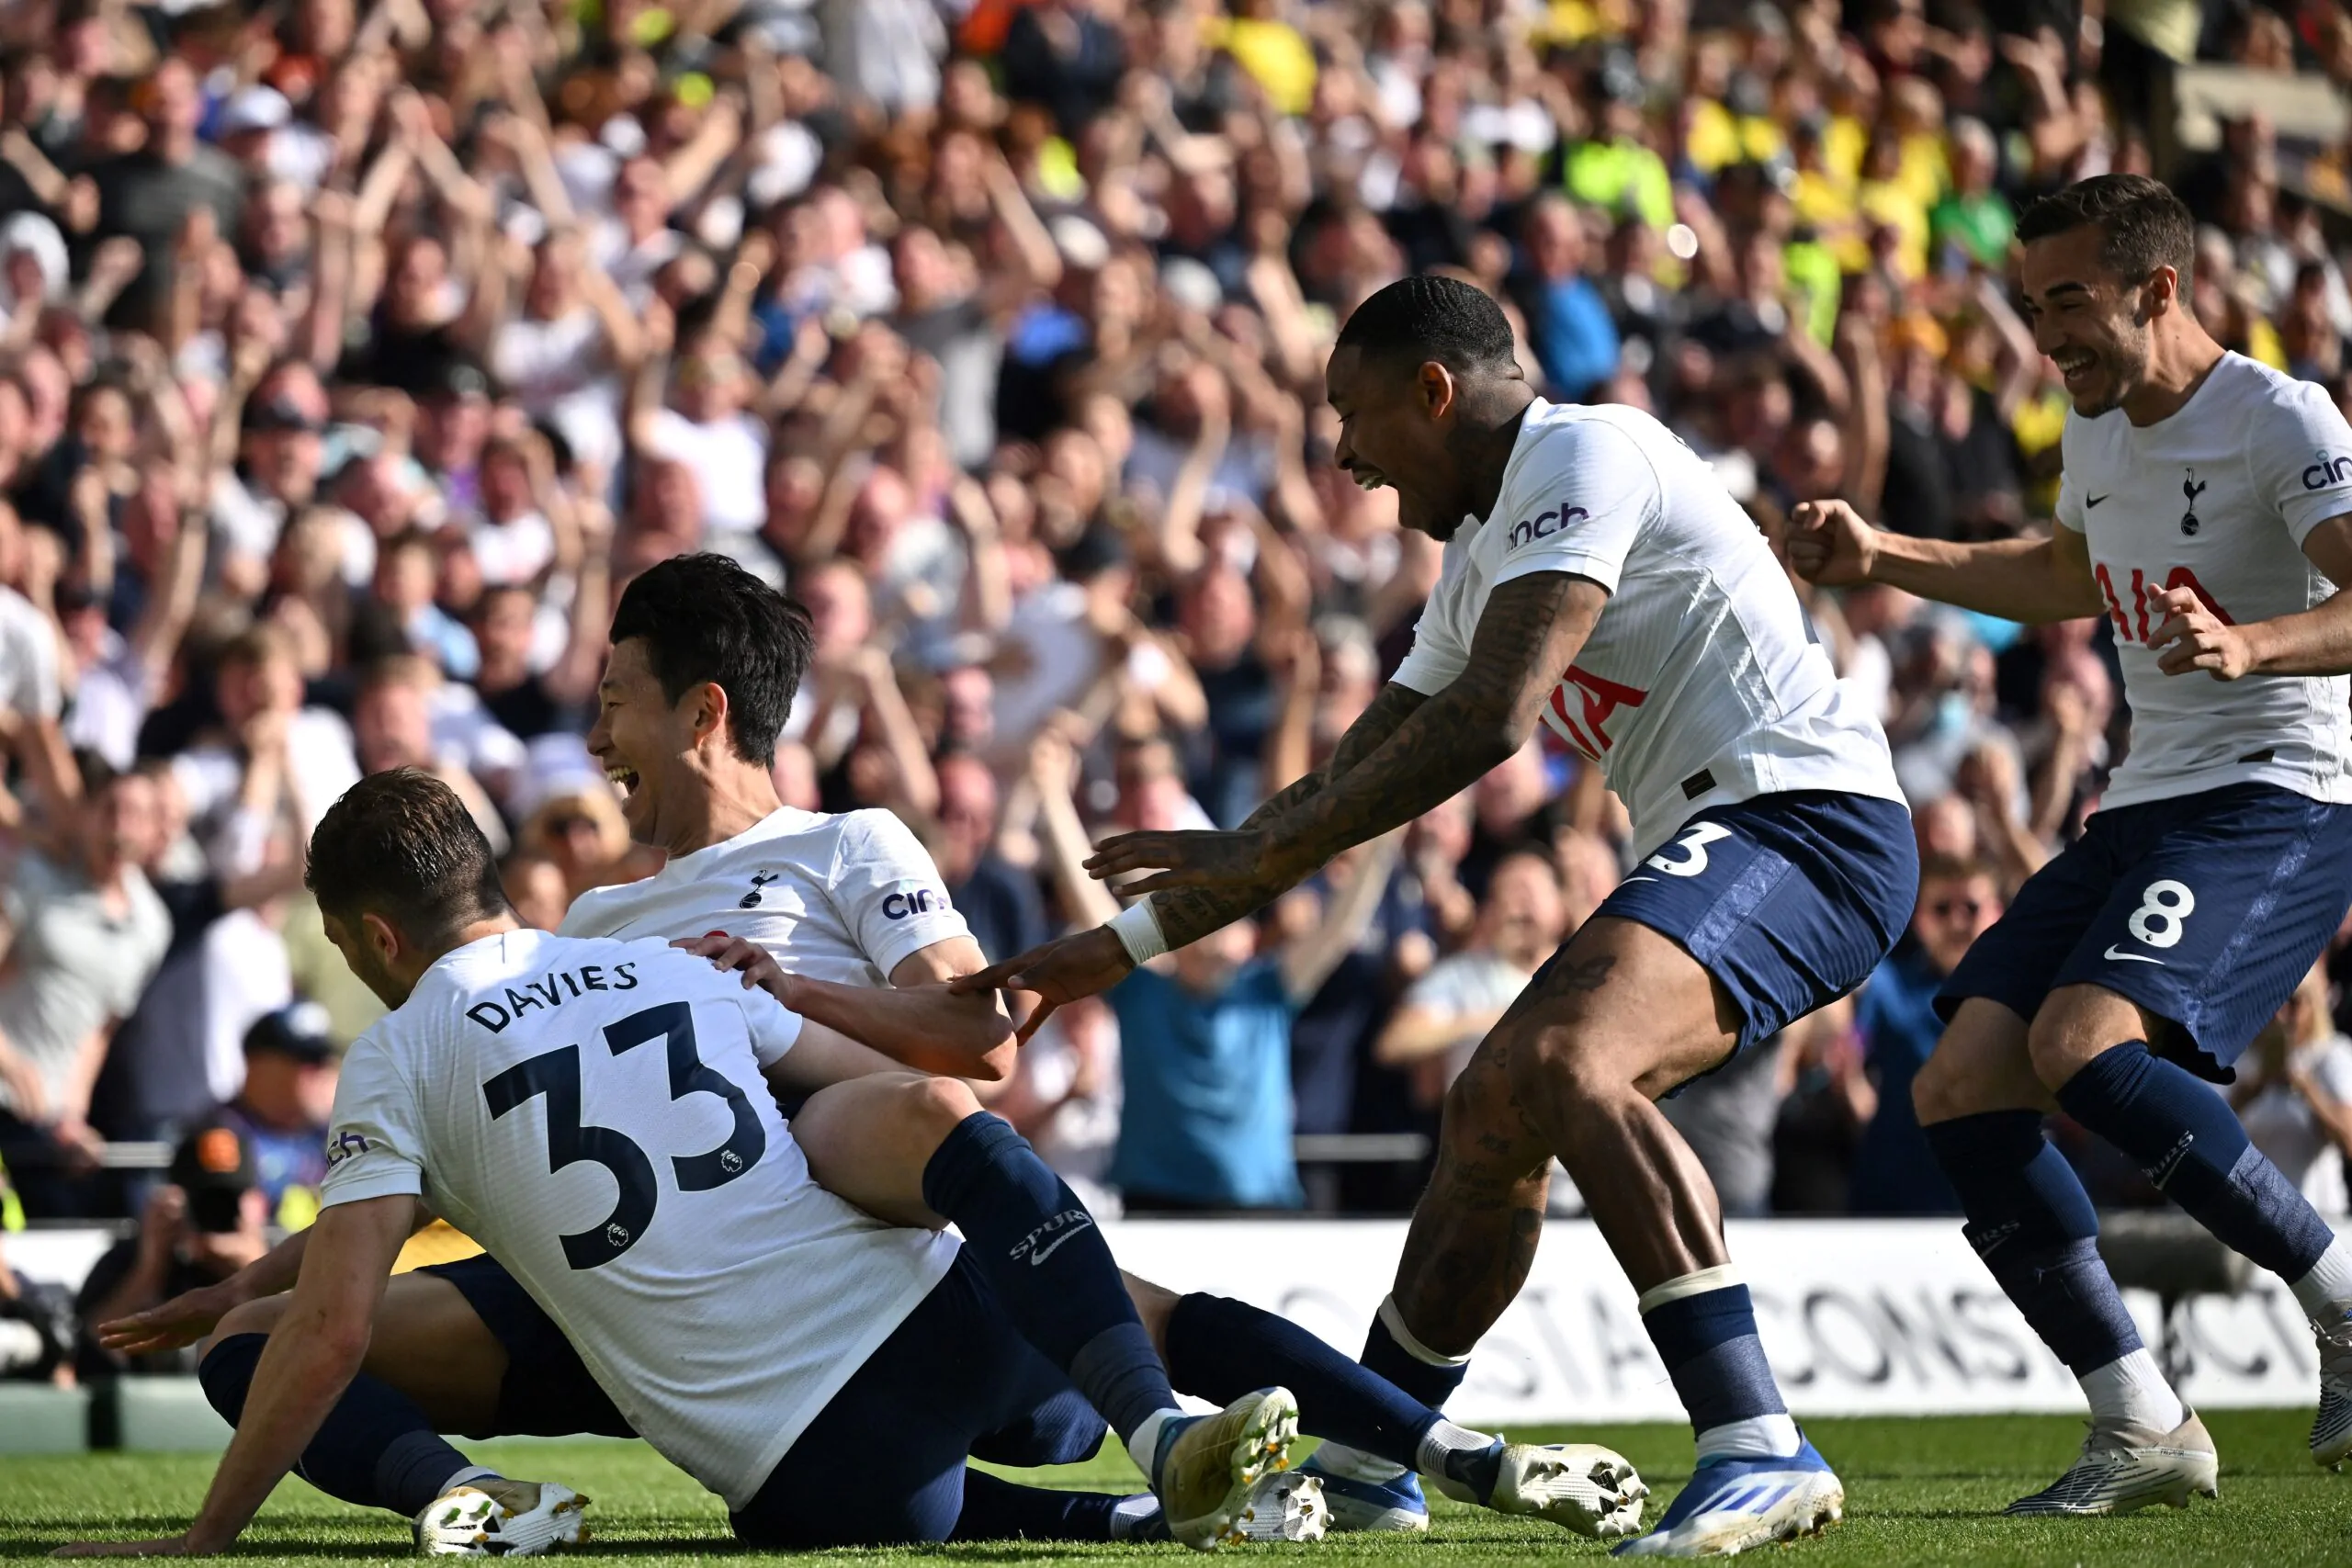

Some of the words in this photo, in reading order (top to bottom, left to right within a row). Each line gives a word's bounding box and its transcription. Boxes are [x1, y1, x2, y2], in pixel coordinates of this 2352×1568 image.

[2128, 879, 2195, 948] 8
[465, 962, 639, 1034] DAVIES
[481, 1000, 766, 1270] 33
